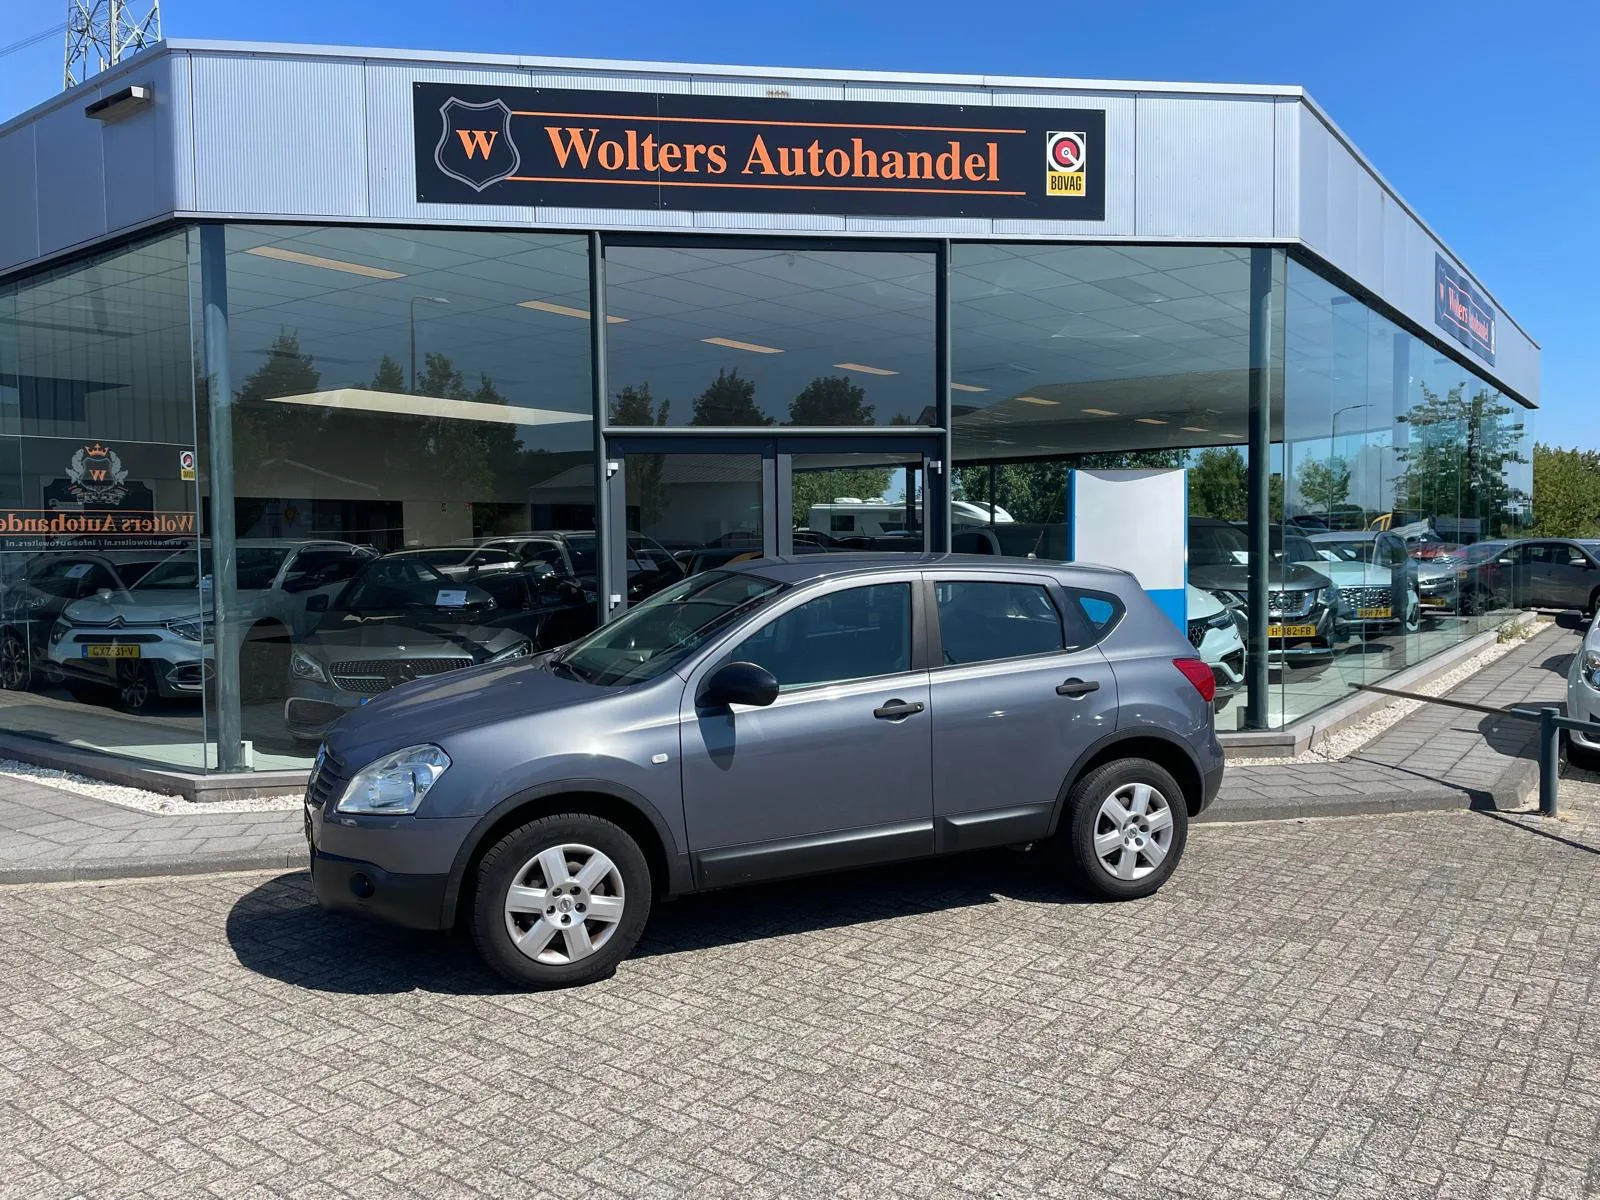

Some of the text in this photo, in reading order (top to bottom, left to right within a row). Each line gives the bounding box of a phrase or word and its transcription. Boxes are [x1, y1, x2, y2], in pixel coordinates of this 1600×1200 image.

[456, 129, 498, 160] W
[544, 126, 1000, 182] Wolters Autohandel
[1050, 176, 1082, 191] BOVAG
